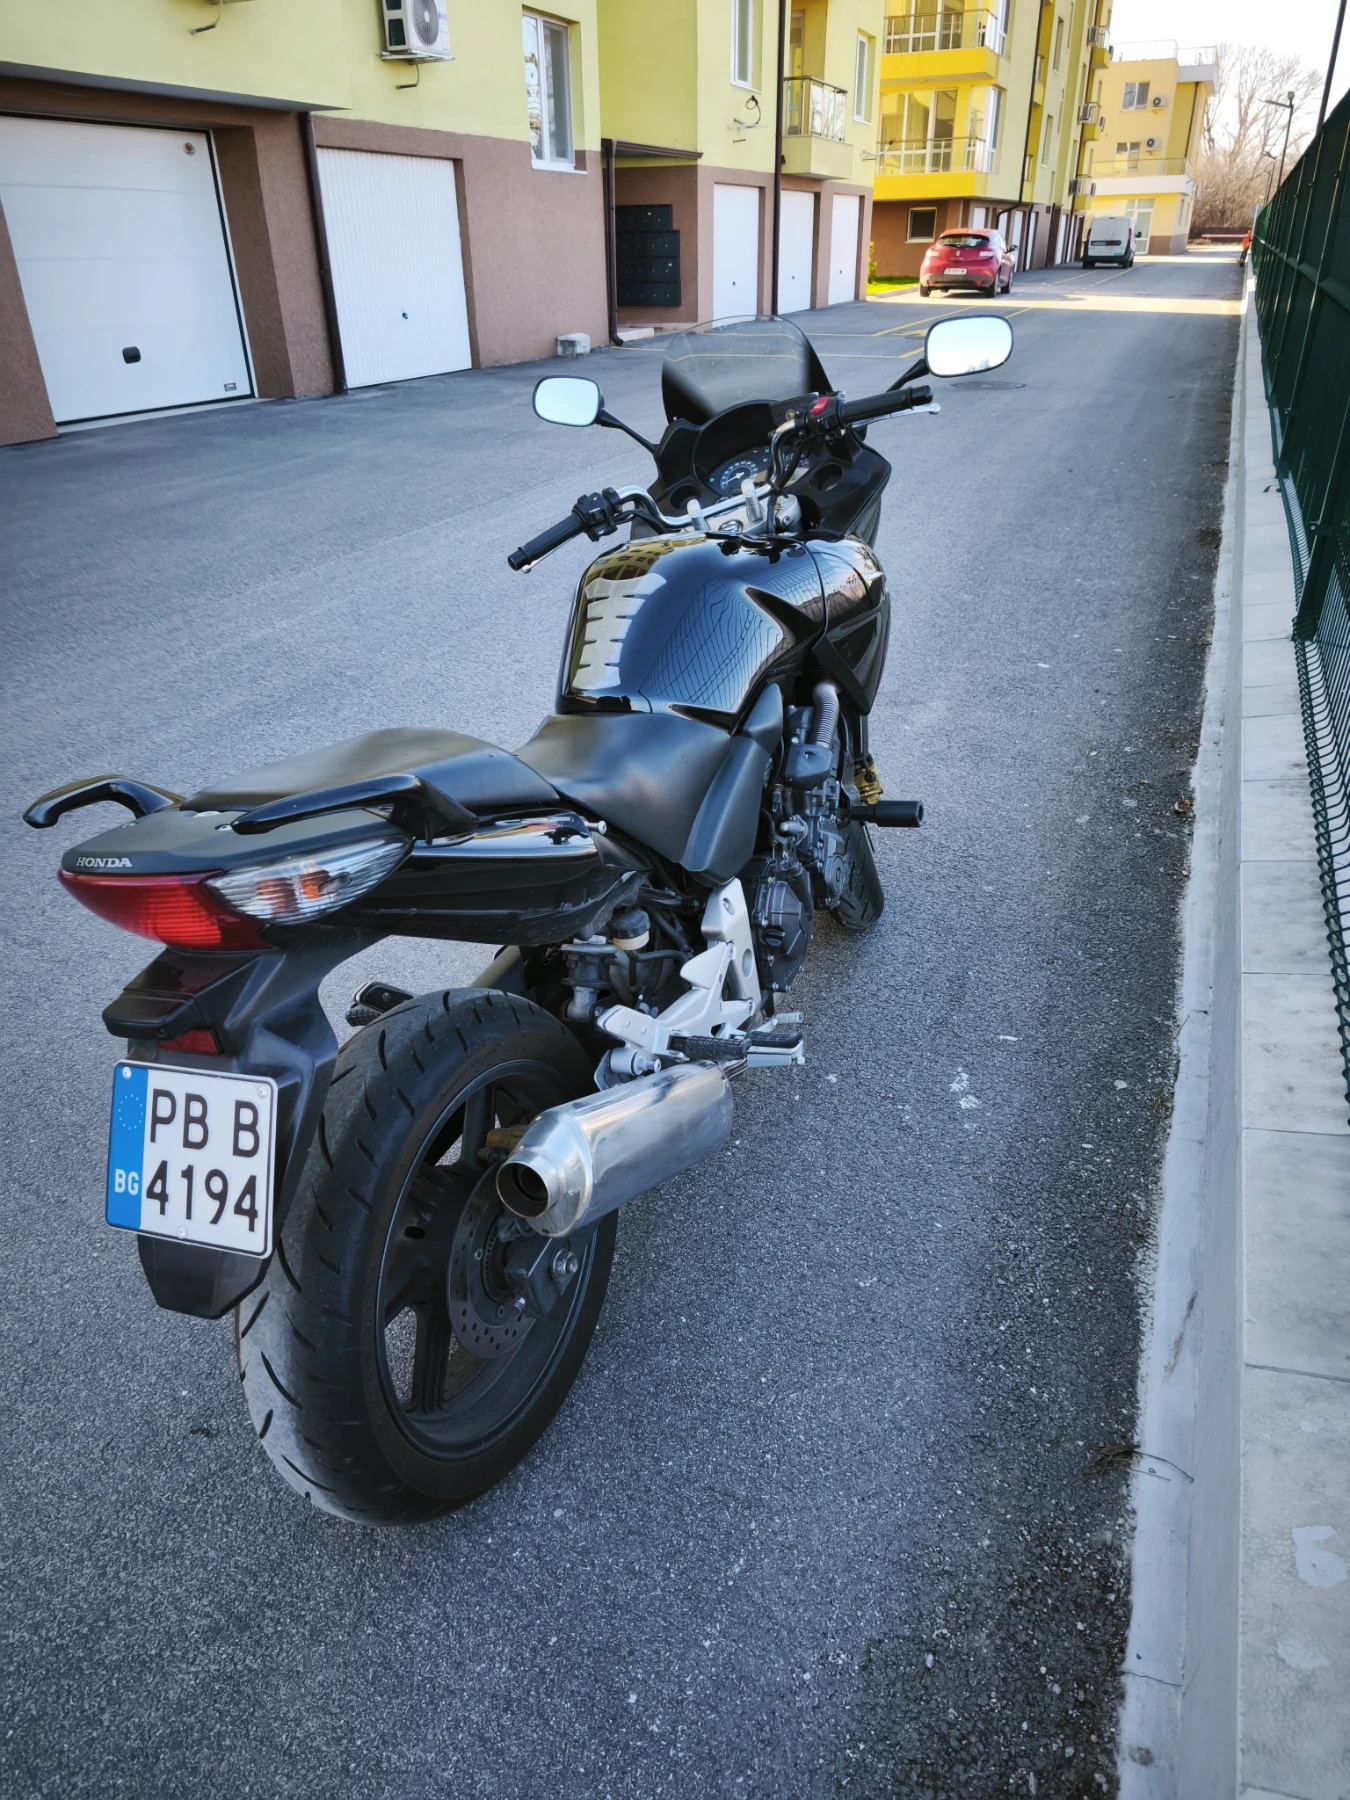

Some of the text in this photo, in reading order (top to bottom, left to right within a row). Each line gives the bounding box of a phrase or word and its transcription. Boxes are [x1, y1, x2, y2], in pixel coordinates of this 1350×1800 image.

[76, 857, 133, 868] HONDA
[150, 1088, 260, 1159] PB B
[114, 1168, 139, 1196] BG
[146, 1160, 259, 1233] 4194
